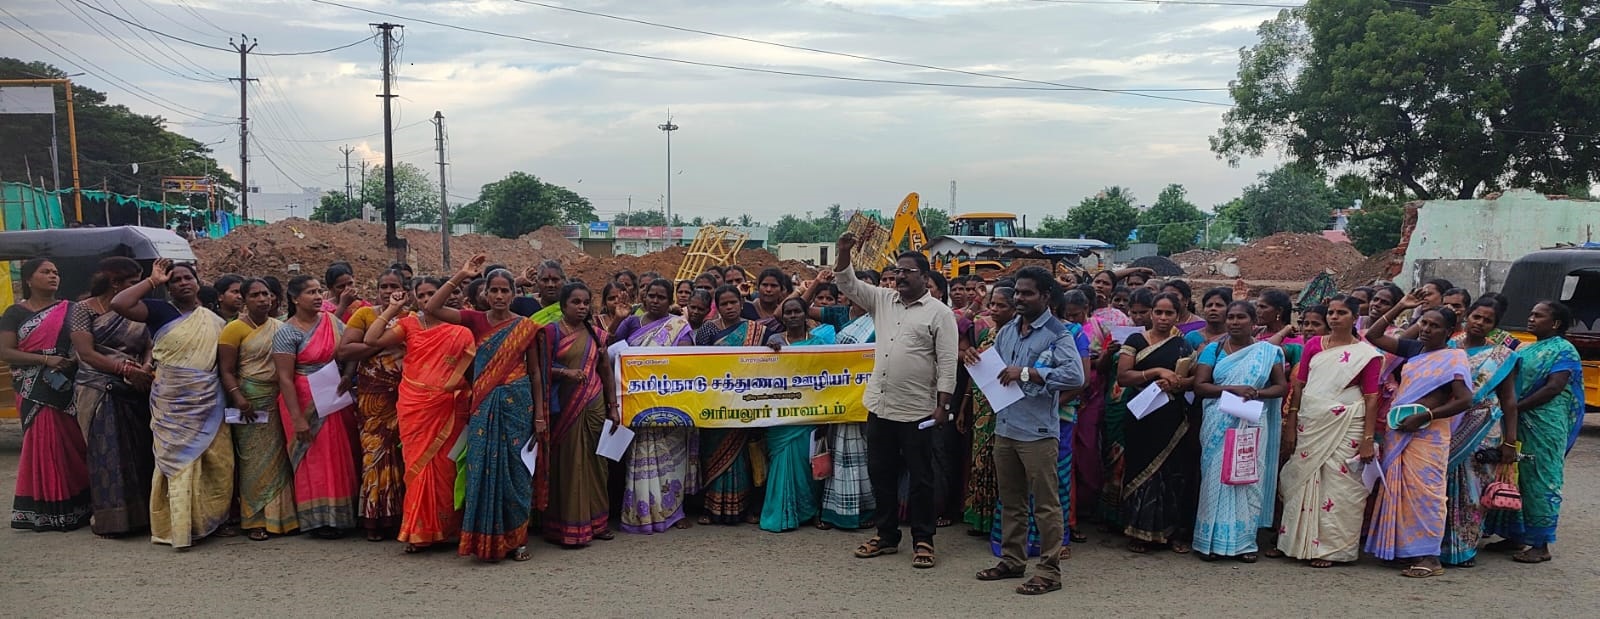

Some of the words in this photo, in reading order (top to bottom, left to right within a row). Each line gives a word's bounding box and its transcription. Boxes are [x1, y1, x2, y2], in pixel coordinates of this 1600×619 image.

[628, 374, 707, 395] தமிழ்நாடு
[712, 373, 788, 395] சத்துணவு
[792, 369, 851, 391] ஊழியர்
[699, 404, 773, 422] அரியலூர்
[776, 401, 846, 418] மாவட்டம்
